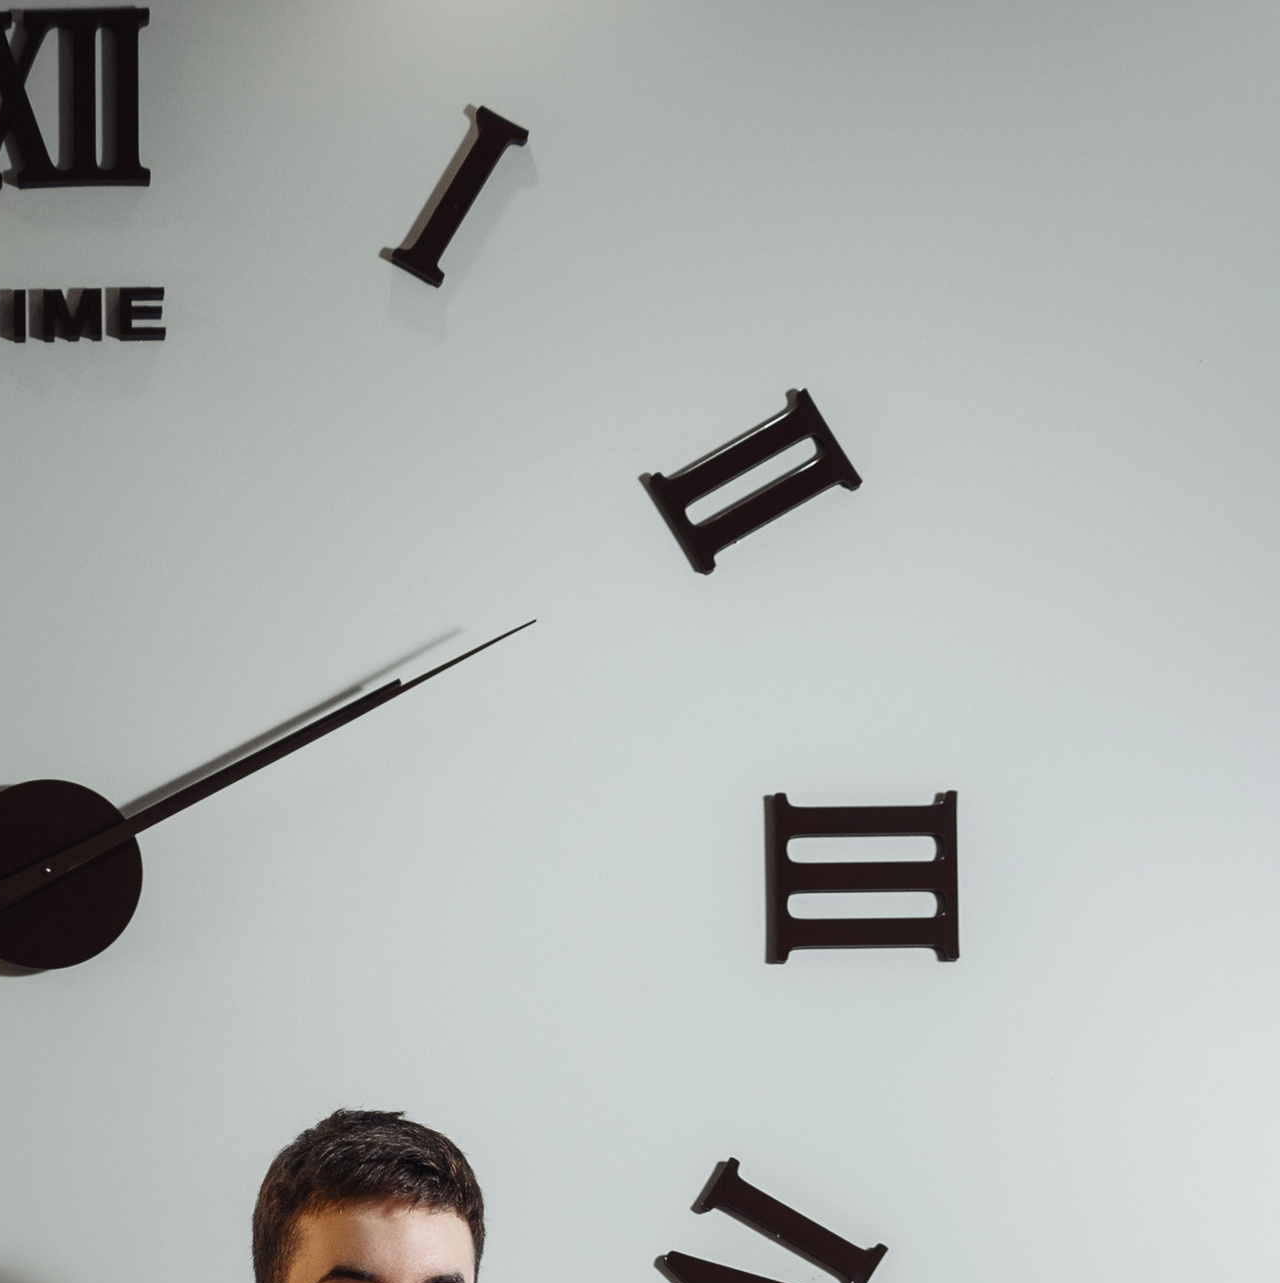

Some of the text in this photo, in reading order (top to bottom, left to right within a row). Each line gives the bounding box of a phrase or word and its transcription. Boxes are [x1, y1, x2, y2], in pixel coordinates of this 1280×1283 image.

[391, 106, 528, 287] I
[647, 389, 862, 574] II
[770, 791, 959, 963] III
